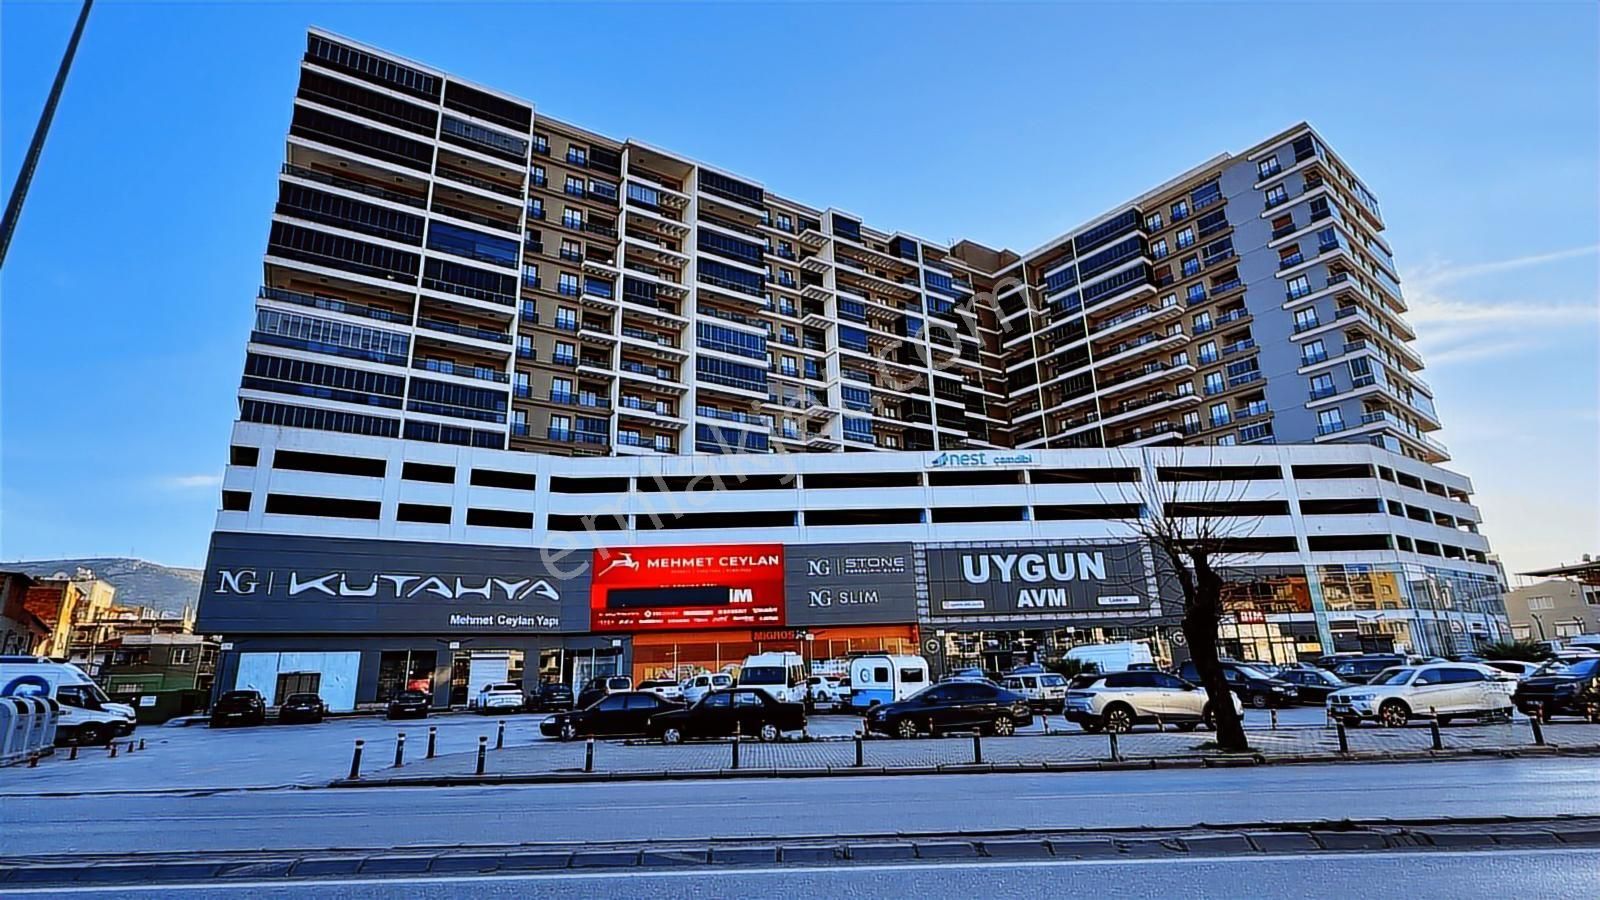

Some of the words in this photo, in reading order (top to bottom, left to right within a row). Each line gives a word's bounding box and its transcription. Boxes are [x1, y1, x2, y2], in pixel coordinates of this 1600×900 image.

[949, 453, 987, 466] nest
[647, 557, 714, 569] MEHMET
[718, 555, 779, 567] CEYLAN
[807, 559, 831, 576] NG
[845, 557, 905, 568] STONE
[962, 551, 1107, 584] UYGUN
[214, 570, 261, 594] NG
[808, 589, 832, 607] NG
[839, 590, 879, 604] SLIM
[1017, 588, 1068, 608] AVM
[450, 614, 493, 626] Mehmet
[497, 615, 535, 627] Ceylan
[754, 630, 795, 640] MIGROS
